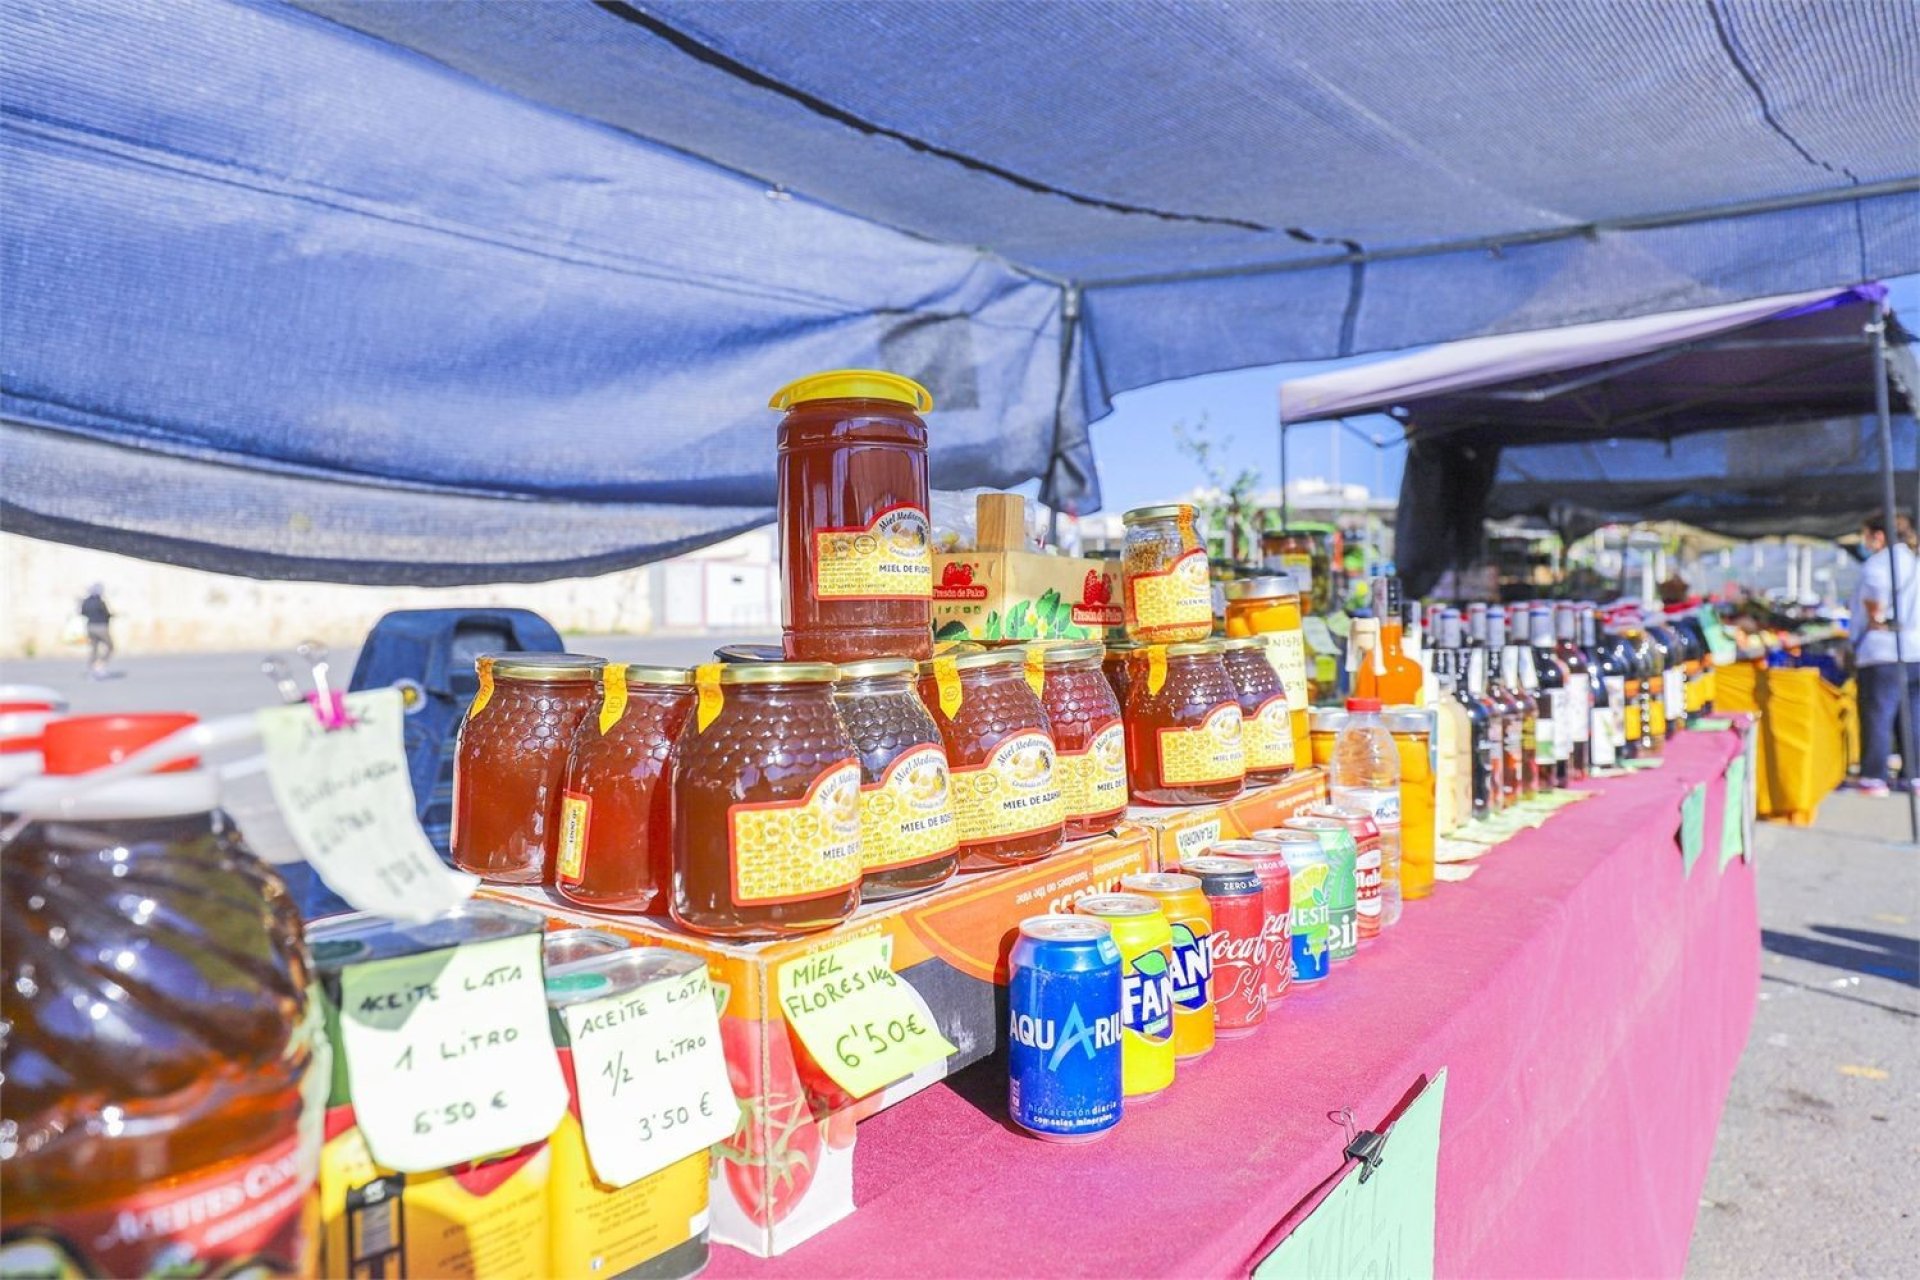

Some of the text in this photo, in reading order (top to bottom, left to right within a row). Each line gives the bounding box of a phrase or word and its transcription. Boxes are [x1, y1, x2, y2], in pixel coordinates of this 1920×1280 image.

[879, 564, 901, 572] MIEL
[903, 565, 913, 573] DE
[1097, 783, 1114, 791] MIEL
[1003, 799, 1027, 810] MIEL
[1030, 796, 1041, 806] DE
[901, 821, 925, 833] MIEL
[928, 816, 938, 828] DE
[823, 846, 845, 860] MIEL
[1223, 881, 1247, 891] ZERO
[464, 965, 522, 991] LATA
[786, 972, 865, 1018] FLORES
[395, 1045, 413, 1071] 1
[602, 1050, 634, 1097] 1/2
[700, 1091, 713, 1117] €
